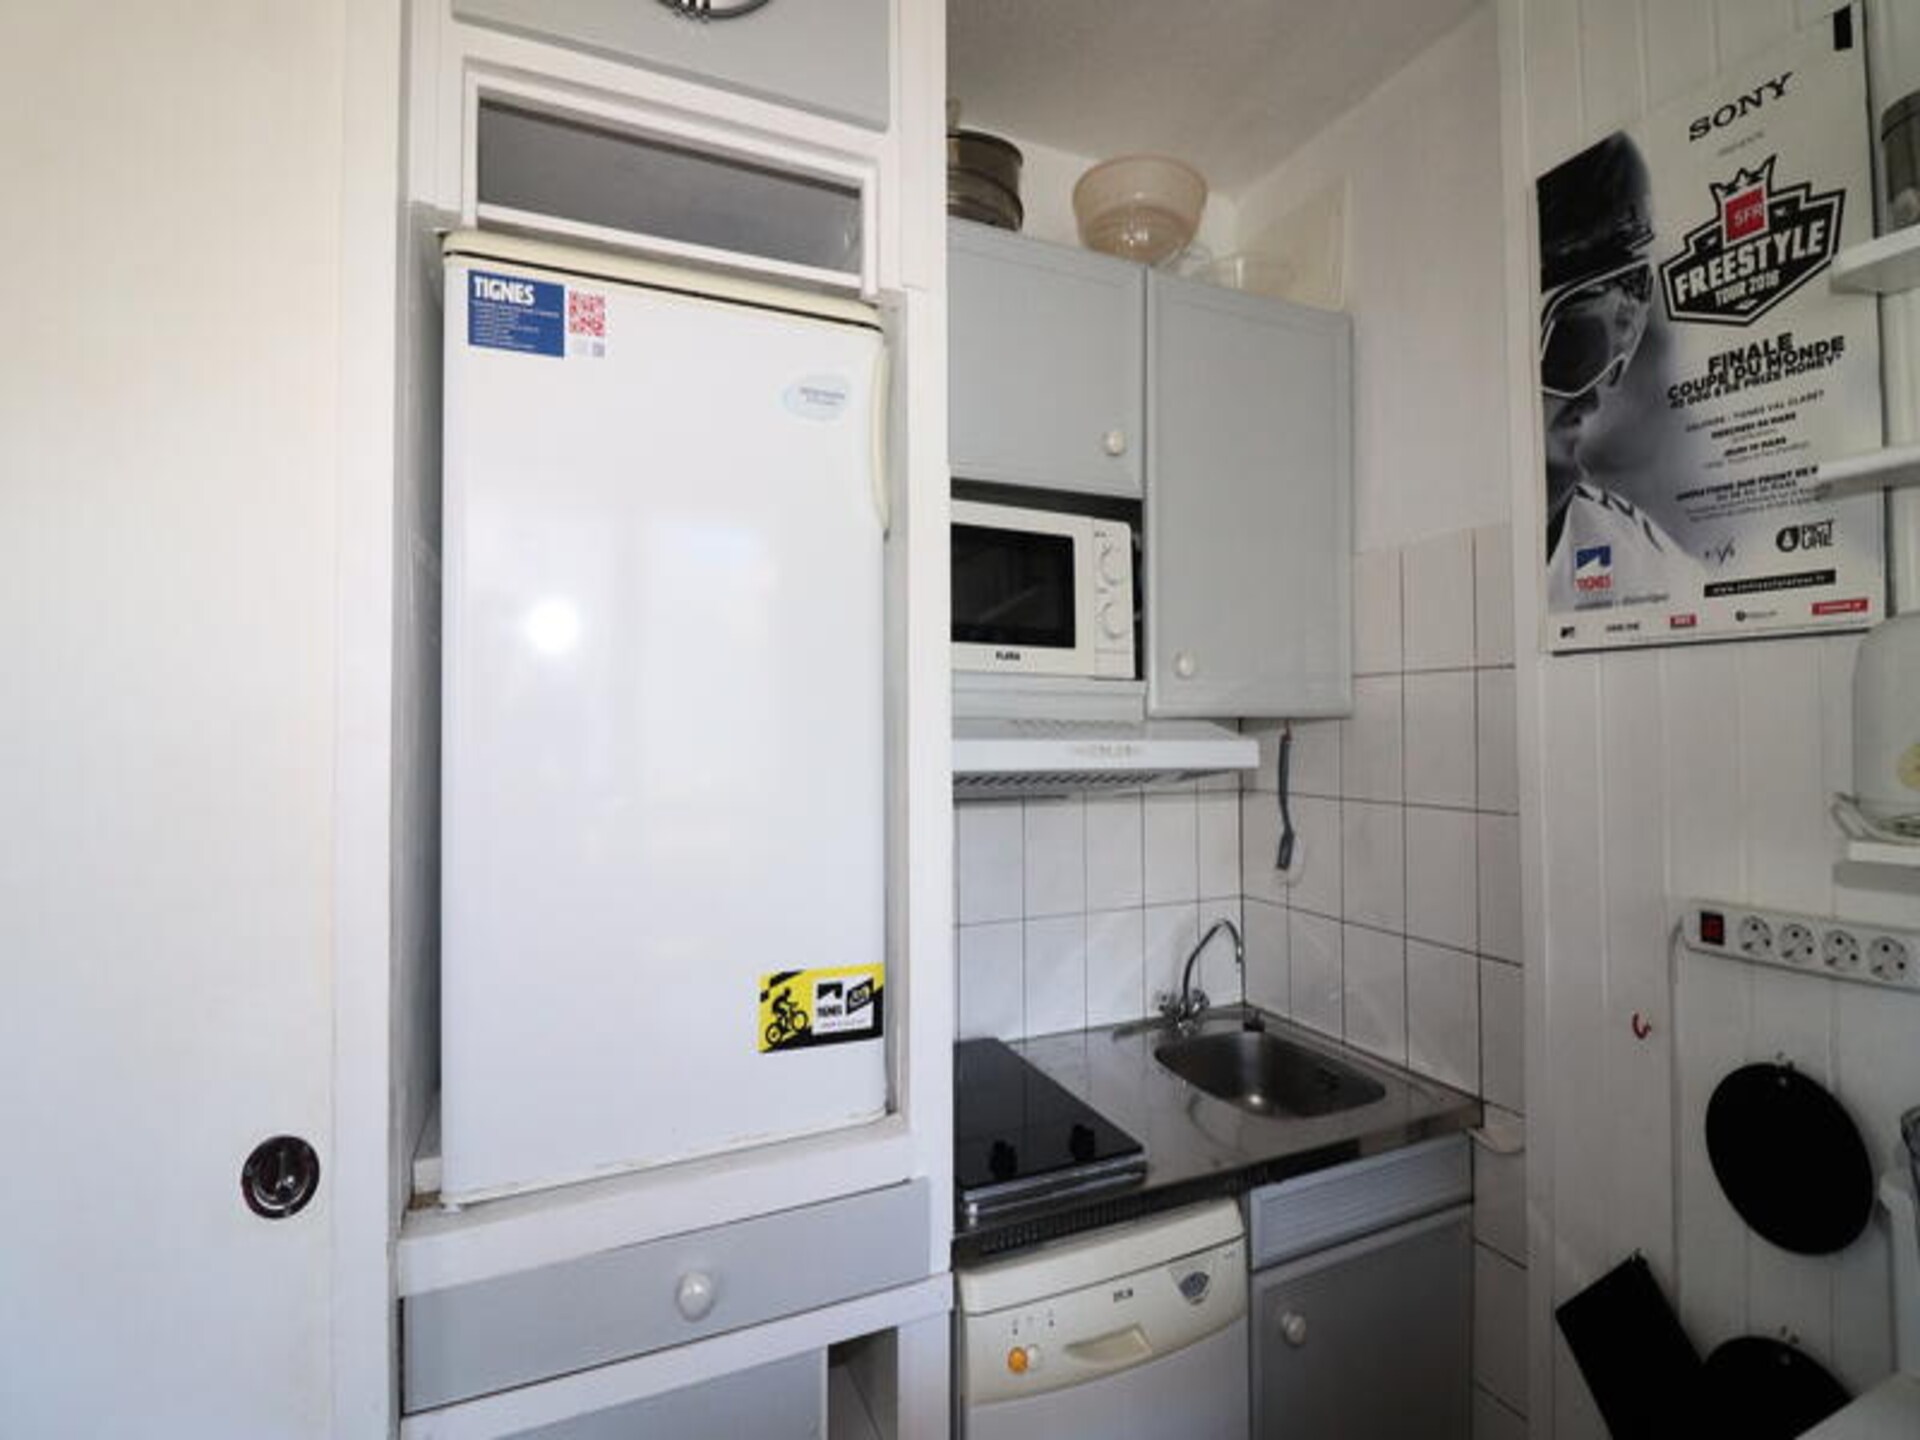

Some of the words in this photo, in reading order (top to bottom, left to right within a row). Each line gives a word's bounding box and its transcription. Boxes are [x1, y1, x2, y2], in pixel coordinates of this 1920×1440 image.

[1689, 71, 1793, 142] SONY
[1733, 203, 1764, 228] SFR
[1674, 218, 1826, 304] FREESTYLE
[473, 275, 536, 306] TIGNES
[1715, 280, 1747, 307] TOUR
[1667, 371, 1728, 400] COUPE
[1735, 357, 1761, 381] DU
[1765, 335, 1845, 371] MONDE
[1708, 332, 1793, 375] FINALE
